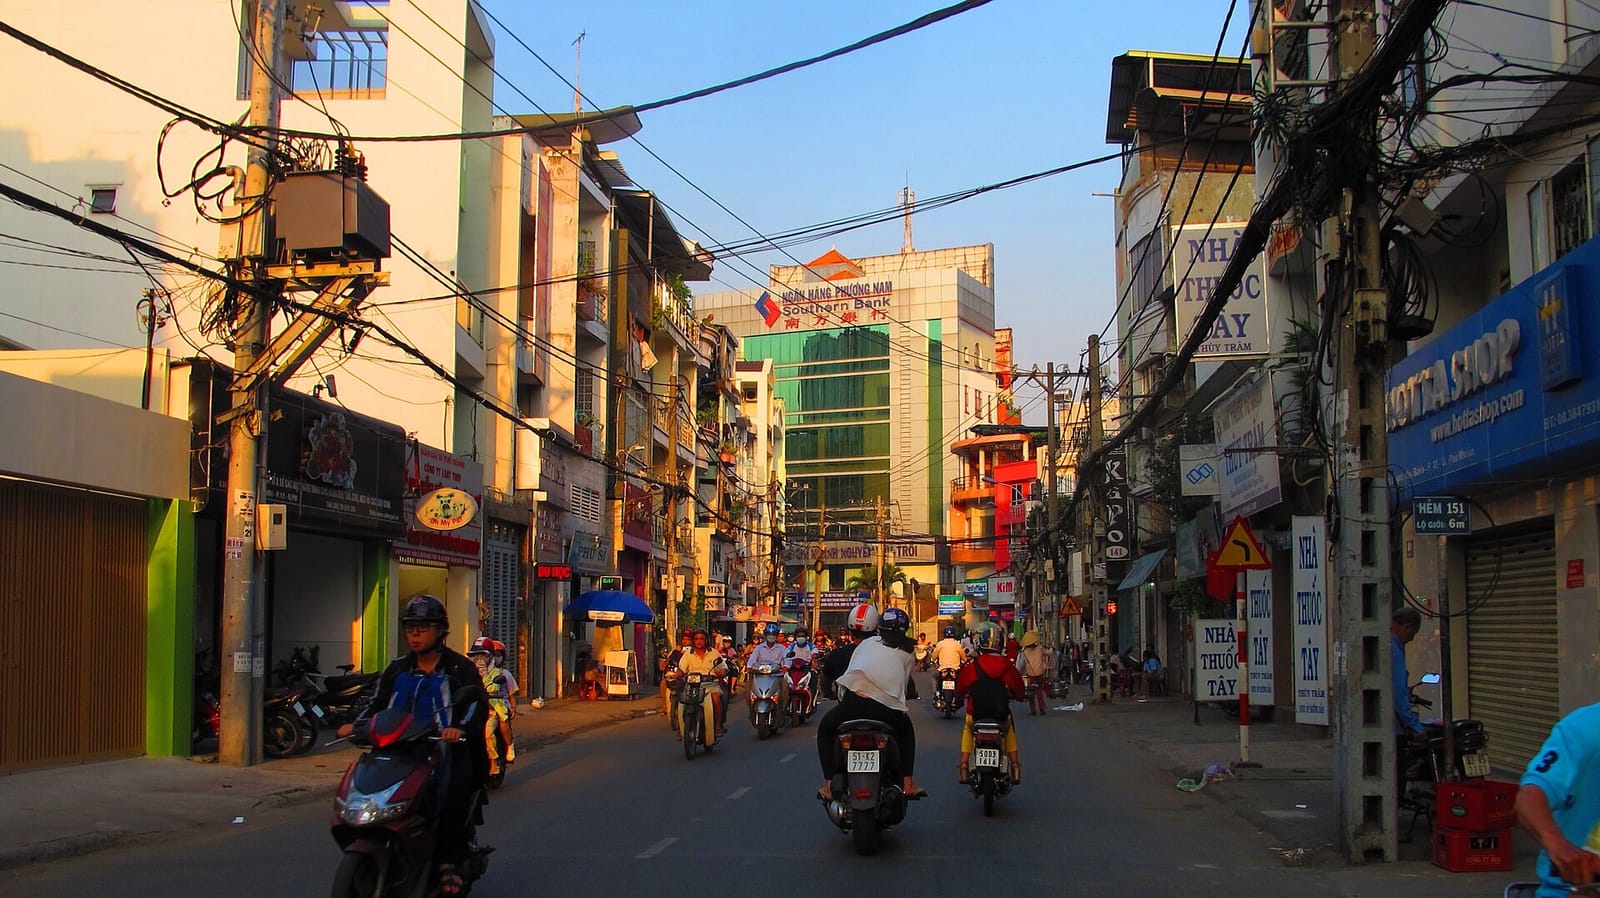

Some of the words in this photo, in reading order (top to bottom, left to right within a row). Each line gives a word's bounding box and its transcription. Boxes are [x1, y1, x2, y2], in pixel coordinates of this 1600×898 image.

[782, 287, 806, 304] NGÂN
[808, 285, 832, 301] HÀNG
[835, 282, 870, 298] PHƯƠNG
[873, 281, 893, 294] NAM
[1184, 274, 1261, 302] THC
[782, 301, 849, 317] Southern
[854, 297, 891, 310] Bank
[1450, 318, 1521, 401] SHOP
[1430, 389, 1525, 443] www.hottashop.com
[1446, 502, 1465, 514] 151
[1448, 518, 1465, 529] 6m
[1298, 525, 1318, 570] NHÀ
[1250, 576, 1271, 619] THUỐC
[1296, 575, 1322, 626] THUỐC
[1204, 622, 1237, 643] NHÀ
[1253, 628, 1269, 666] TÂY
[1301, 637, 1319, 682] TÂY
[1207, 675, 1237, 697] TÂY
[852, 761, 875, 771] 7777
[1535, 750, 1559, 773] 3
